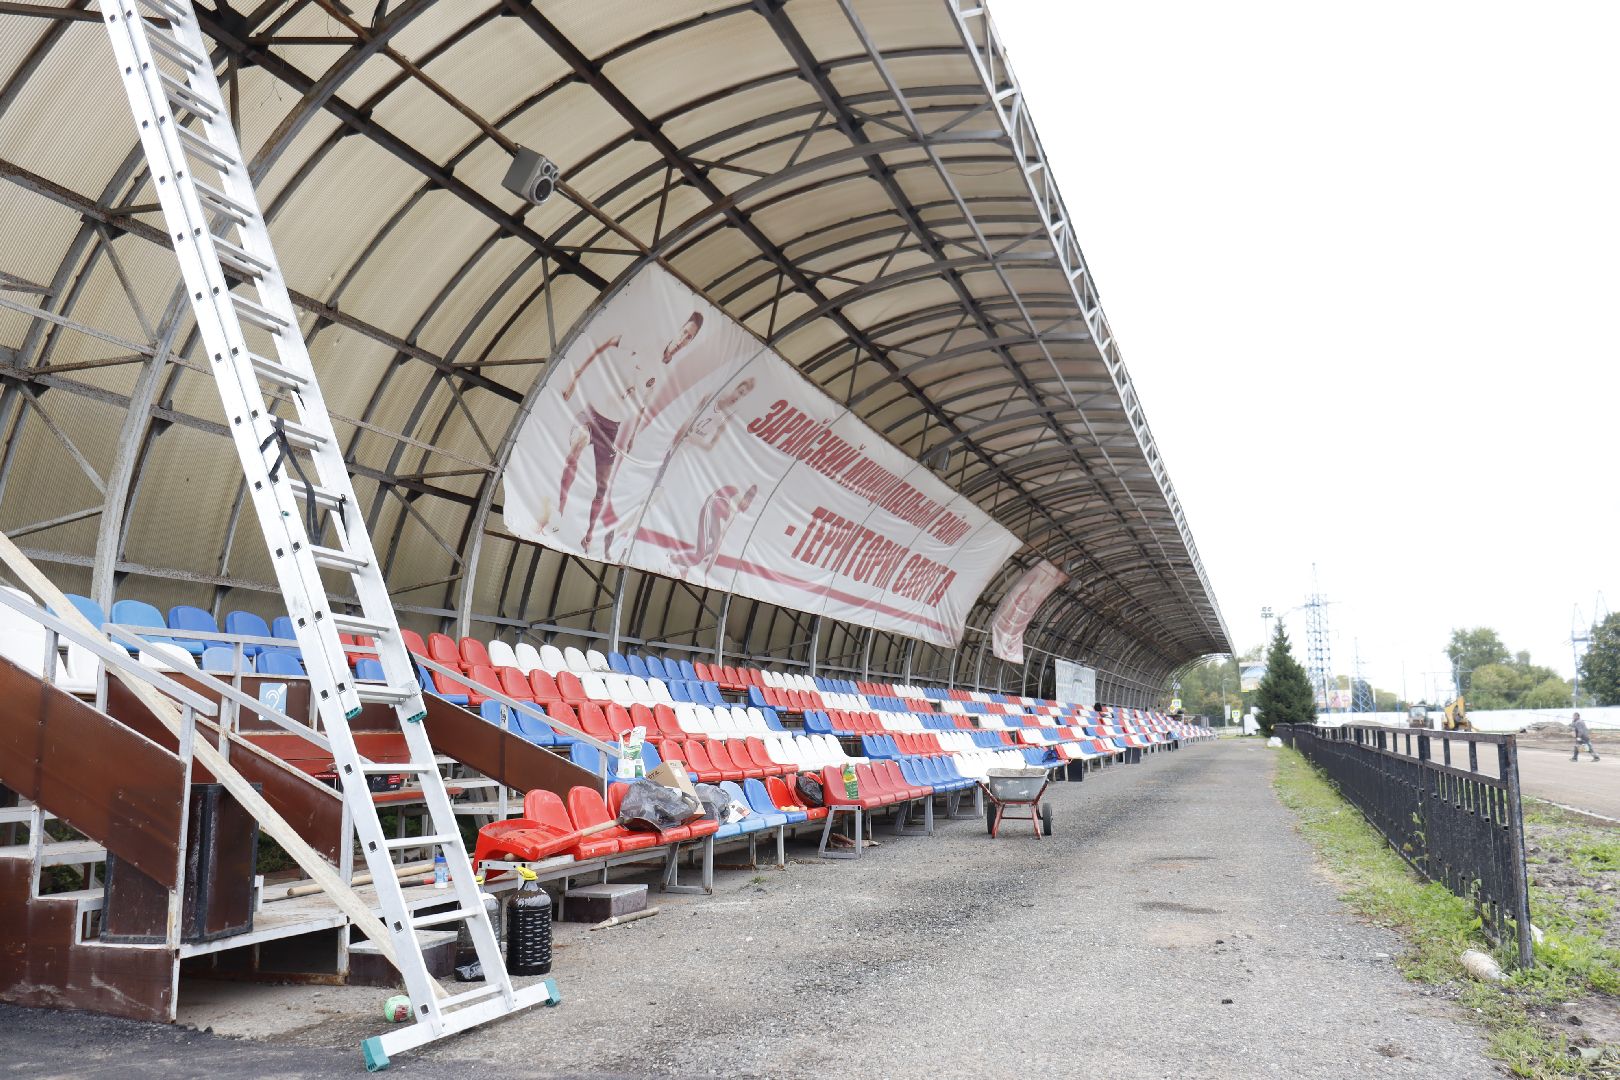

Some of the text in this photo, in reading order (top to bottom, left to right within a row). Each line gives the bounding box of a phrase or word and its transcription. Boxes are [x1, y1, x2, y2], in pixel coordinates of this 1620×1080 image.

[747, 399, 866, 483] ЗАРАЙСКИЙ
[926, 511, 972, 546] РАЙОН
[791, 506, 911, 590] ТЕРРИТОРИЯ
[891, 553, 958, 608] СПОРТА
